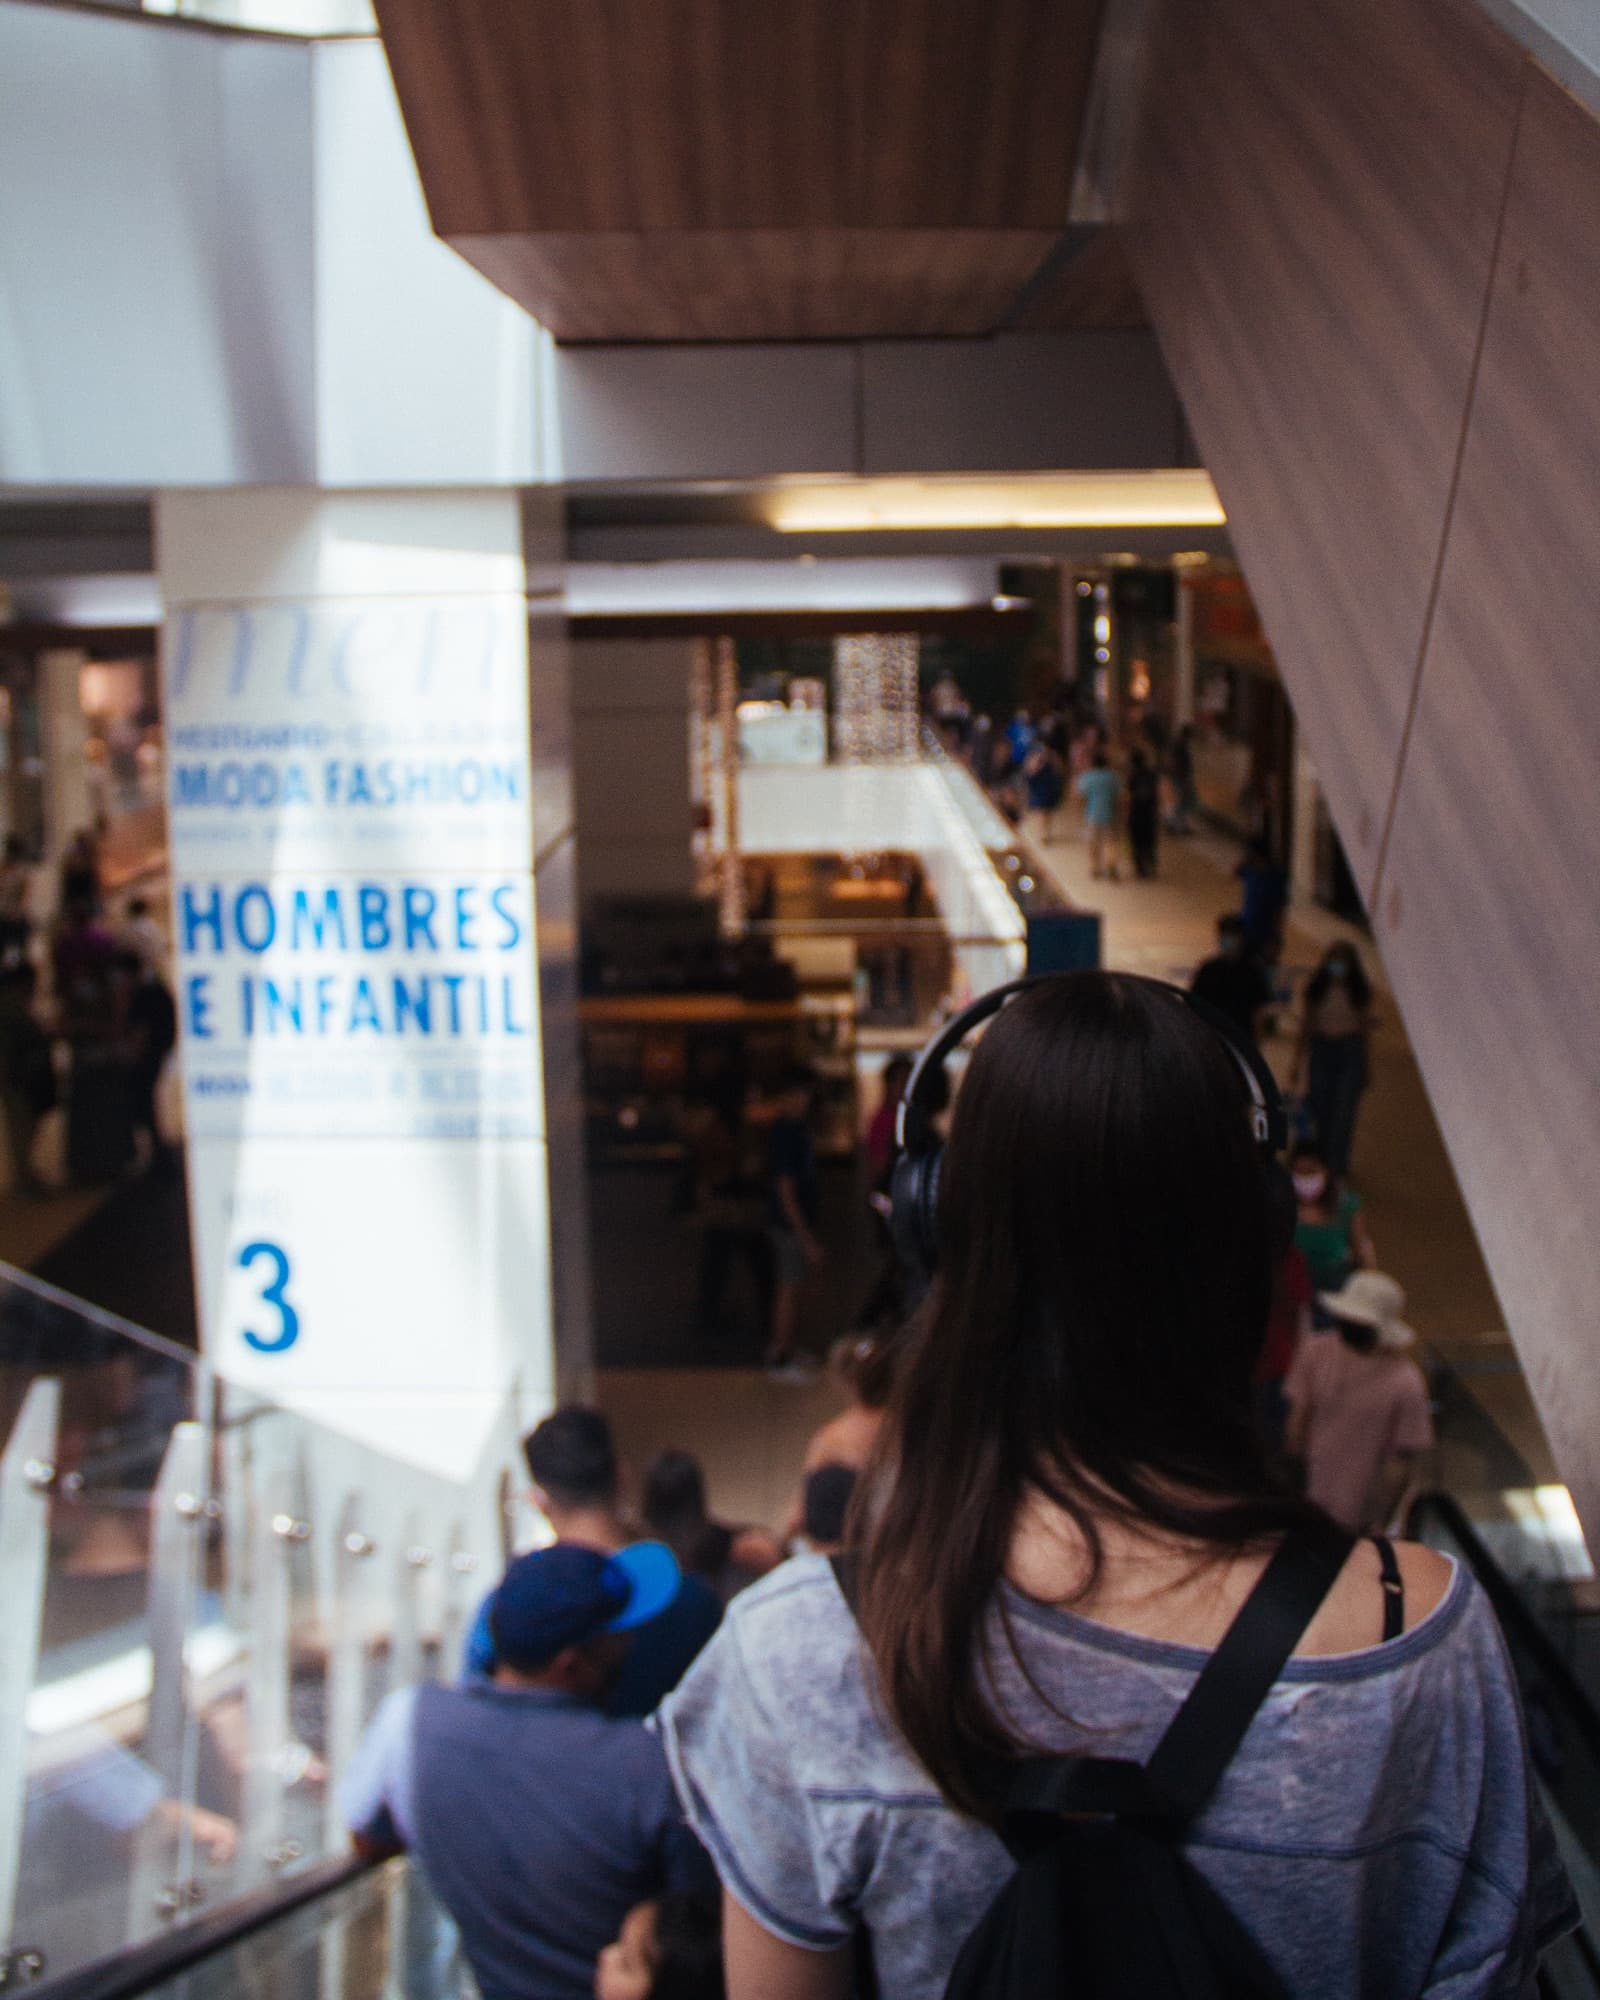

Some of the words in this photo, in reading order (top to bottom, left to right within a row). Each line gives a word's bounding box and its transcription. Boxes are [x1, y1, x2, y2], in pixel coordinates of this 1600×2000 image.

[173, 759, 309, 807] MODA
[324, 757, 519, 806] FASHION
[179, 881, 521, 954] HOMBRES
[186, 971, 215, 1038] E
[239, 971, 527, 1037] INFANTIL
[237, 1241, 299, 1353] 3
